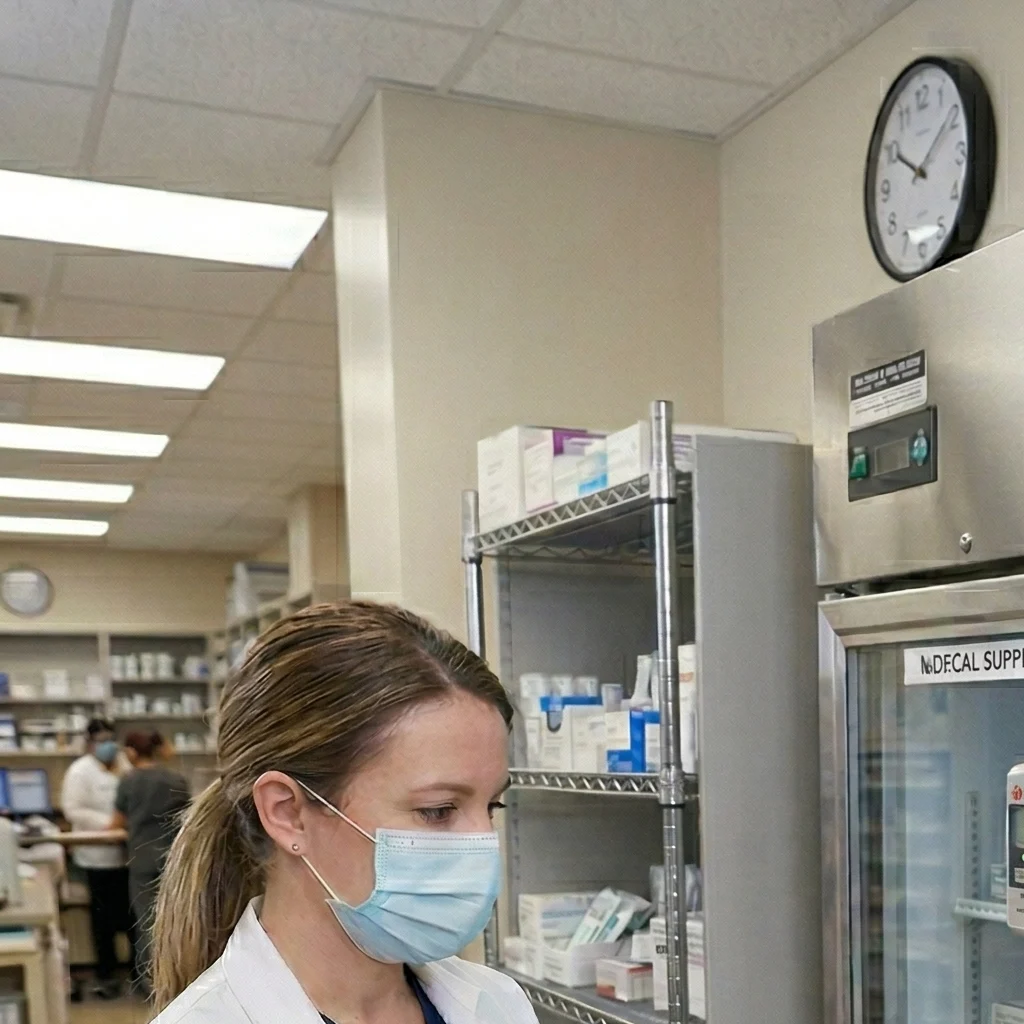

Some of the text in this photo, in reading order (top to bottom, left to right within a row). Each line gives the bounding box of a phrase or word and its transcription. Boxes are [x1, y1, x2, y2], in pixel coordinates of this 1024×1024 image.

[914, 84, 929, 110] 12
[955, 141, 967, 166] 3
[880, 179, 891, 203] 9
[887, 212, 898, 236] 8
